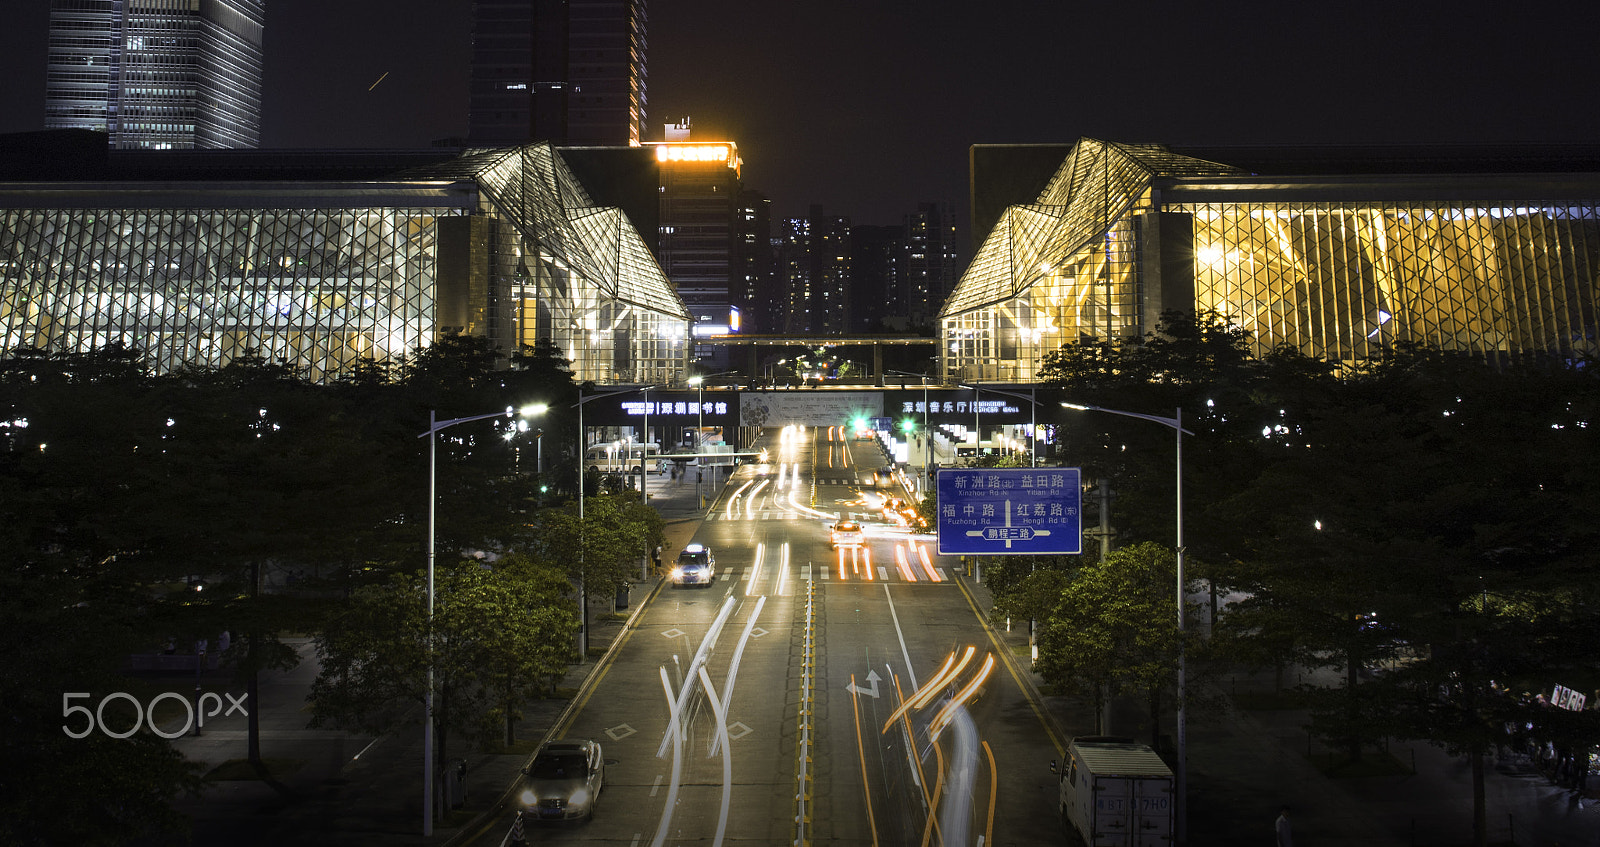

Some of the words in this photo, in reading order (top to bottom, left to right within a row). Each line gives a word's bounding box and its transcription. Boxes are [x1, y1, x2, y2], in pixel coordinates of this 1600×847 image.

[661, 402, 727, 415] 深圳图书馆
[902, 401, 967, 413] 深圳音乐厅
[1021, 474, 1064, 488] 益田路
[942, 504, 995, 518] 福中路
[947, 518, 977, 526] Fuzhong
[988, 529, 1030, 539] 鹏程三路
